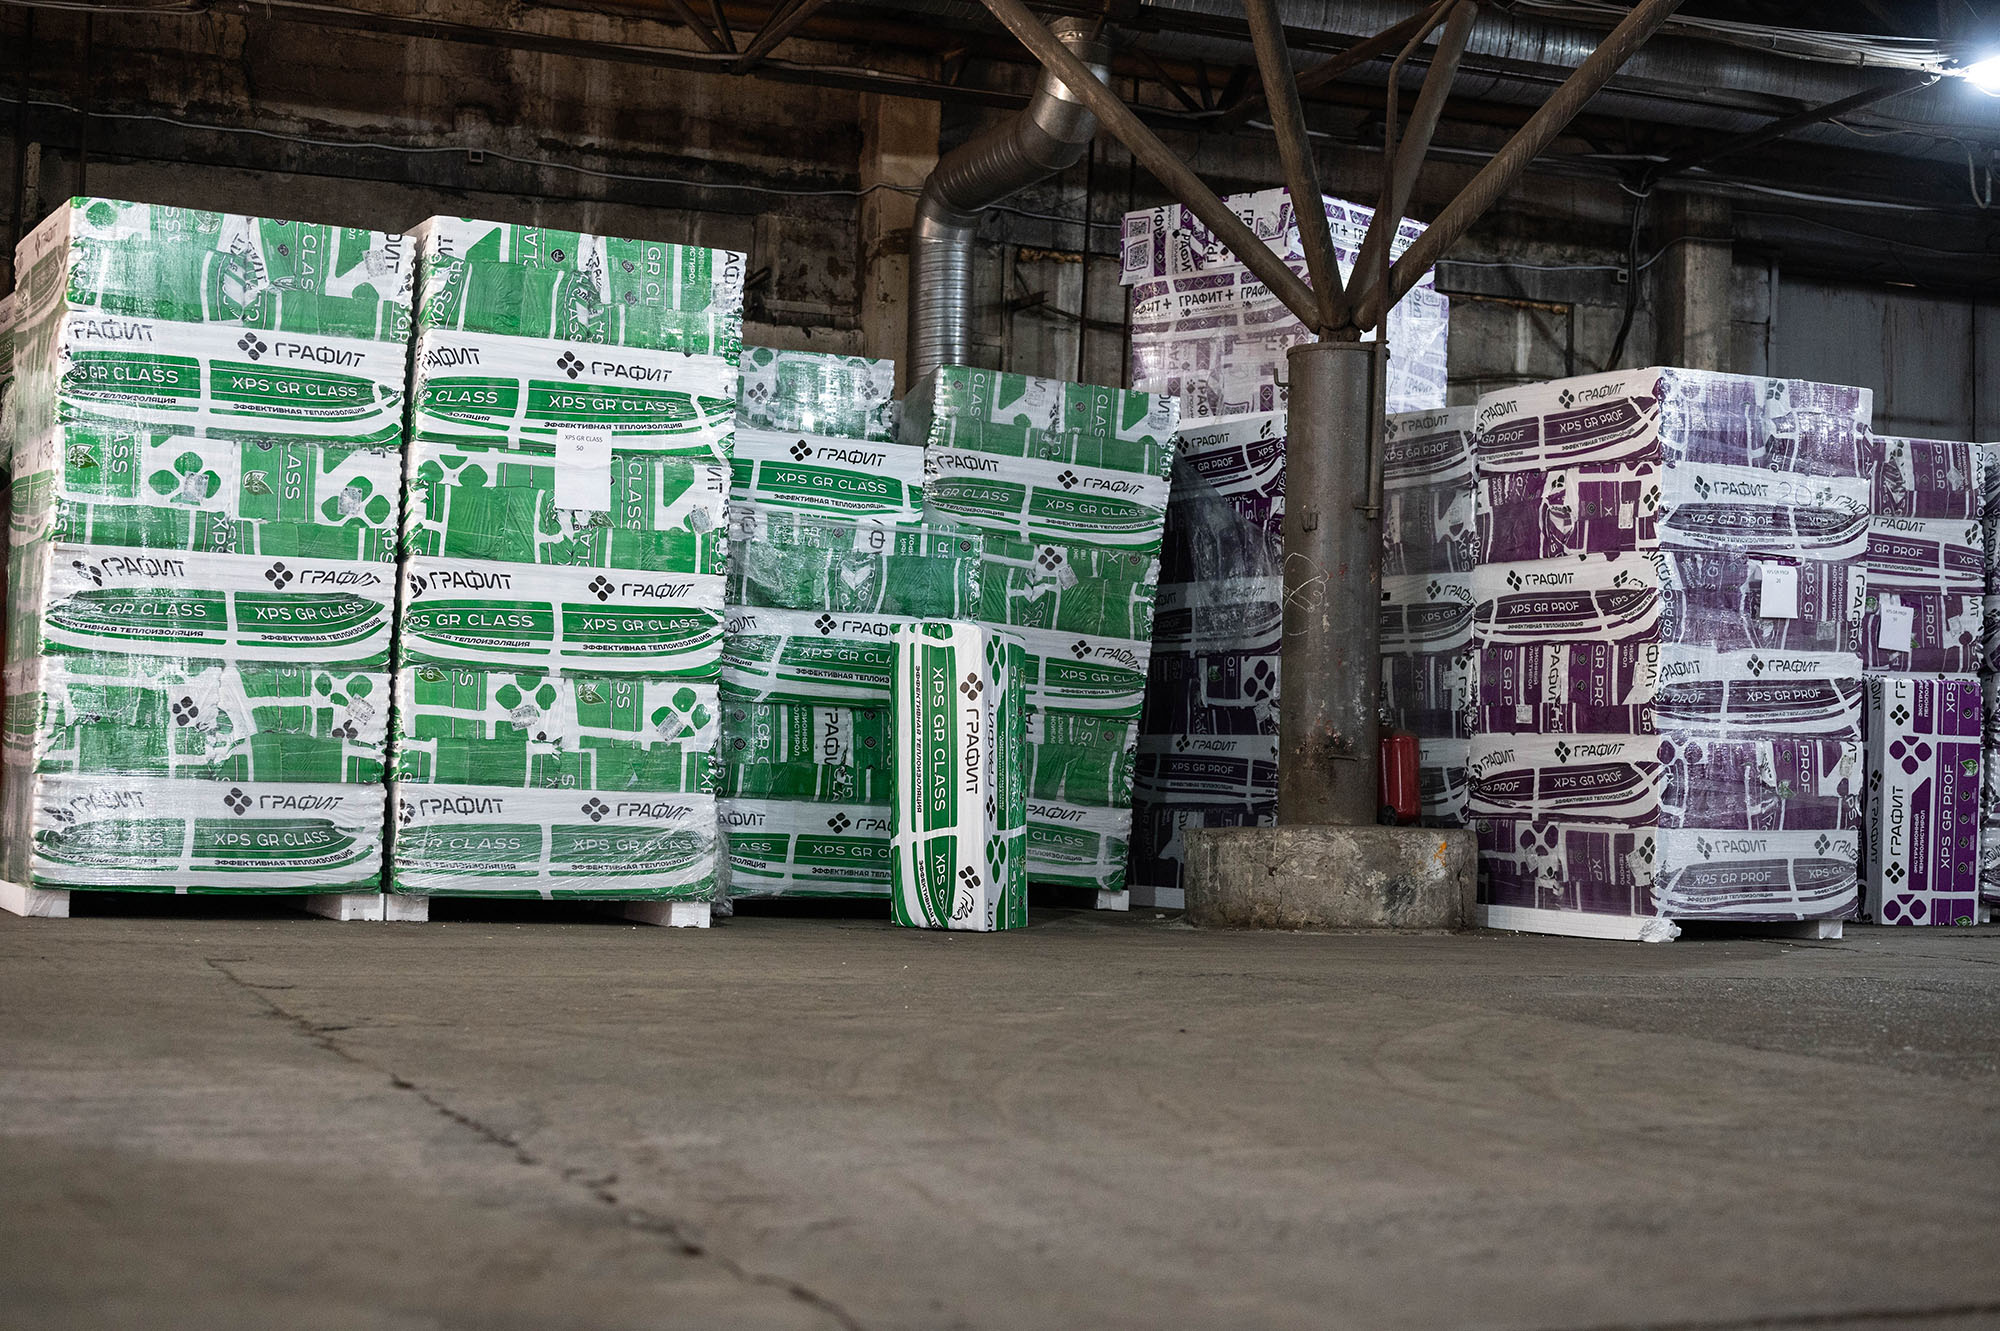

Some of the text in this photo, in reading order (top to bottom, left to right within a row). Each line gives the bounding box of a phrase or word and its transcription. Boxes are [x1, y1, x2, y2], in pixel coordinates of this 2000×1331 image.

[646, 247, 661, 275] GR
[274, 342, 365, 368] ГРАФИТ
[113, 367, 179, 383] CLASS
[591, 361, 672, 383] ГРАФИТ
[231, 376, 358, 398] XPS GR CLASS
[1578, 383, 1625, 402] ГРАФИТ
[436, 391, 498, 403] CLASS
[549, 395, 678, 413] XPS GR CLASS
[233, 404, 301, 415] ЭФФЕКТИВНАЯ
[1480, 401, 1518, 424] ГРАФИТ
[544, 422, 612, 431] ЭФФЕКТИВНАЯ
[1401, 415, 1449, 432] ГРАФИТ
[1559, 410, 1624, 433] XPS GR PROF
[1191, 432, 1230, 449] ГРАФИТ
[1497, 430, 1524, 441] PROF
[817, 447, 886, 467] ГРАФИТ
[1406, 448, 1420, 458] GR
[1423, 442, 1449, 455] PROF
[936, 455, 999, 472] ГРАФИТ
[1198, 457, 1233, 471] GR PROF
[776, 472, 887, 494] XPS GR CLASS
[1083, 477, 1145, 496] ГРАФИТ
[1936, 470, 1945, 489] GR
[774, 494, 830, 505] ЭФФЕКТИВНАЯ
[963, 489, 1010, 502] CLASS
[1045, 500, 1074, 512] XPS
[1079, 504, 1097, 514] GR
[1872, 517, 1926, 533] ГРАФИТ
[1875, 545, 1924, 558] GR PROF
[101, 556, 185, 578] ГРАФИТ
[430, 571, 511, 591] ГРАФИТ
[1525, 572, 1574, 586] ГРАФИТ
[622, 583, 695, 599] ГРАФИТ
[109, 602, 206, 617] GR CLASS
[255, 602, 365, 621] XPS GR CLASS
[1510, 601, 1580, 614] XPS GR PROF
[436, 614, 534, 628] GR CLASS
[582, 617, 700, 631] XPS GR CLASS
[1421, 611, 1441, 623] XPS
[1925, 605, 1935, 644] PROF
[120, 627, 203, 637] ТЕПЛОИЗОЛЯЦИЯ
[261, 633, 325, 642] ЭФФЕКТИВНАЯ
[453, 635, 530, 647] ТЕПЛОИЗОЛЯЦИЯ
[838, 650, 859, 662] GR
[1594, 645, 1605, 669] GR
[796, 668, 854, 679] ЭФФЕКТИВНАЯ
[1768, 660, 1820, 673] ГРАФИТ
[1060, 669, 1109, 682] XPS GR
[1503, 666, 1512, 690] GR
[1671, 693, 1706, 703] PROF
[1746, 688, 1821, 702] XPS GR PROF
[1946, 683, 1956, 712] XPS
[1642, 708, 1651, 732] GR
[932, 666, 946, 812] XPS GR CLASS
[1192, 740, 1238, 751] ГРАФИТ
[966, 708, 980, 794] ГРАФИТ
[1574, 743, 1625, 757] ГРАФИТ
[915, 739, 923, 813] ТЕПЛОИЗОЛЯЦИЯ
[1171, 763, 1235, 774] XPS GR PROF
[1800, 744, 1811, 794] PROF
[1493, 781, 1520, 792] PROF
[1554, 770, 1622, 788] XPS GR PROF
[259, 795, 344, 811] ГРАФИТ
[419, 796, 503, 816] ГРАФИТ
[1027, 803, 1086, 823] РАФИТ
[1890, 785, 1903, 856] ГРАФИТ
[1941, 764, 1954, 868] XPS GR PROF
[214, 831, 330, 847] XPS GR CLASS
[450, 838, 521, 849] CLASS
[572, 839, 610, 851] XPS
[1031, 831, 1084, 847] CLASS
[1714, 838, 1768, 854] ГРАФИТ
[812, 844, 873, 857] XPS GR
[214, 859, 286, 867] ЭФФЕКТИВНАЯ
[936, 853, 946, 885] XPS
[1692, 871, 1772, 885] XPS GR PROF
[1809, 868, 1829, 879] XPS
